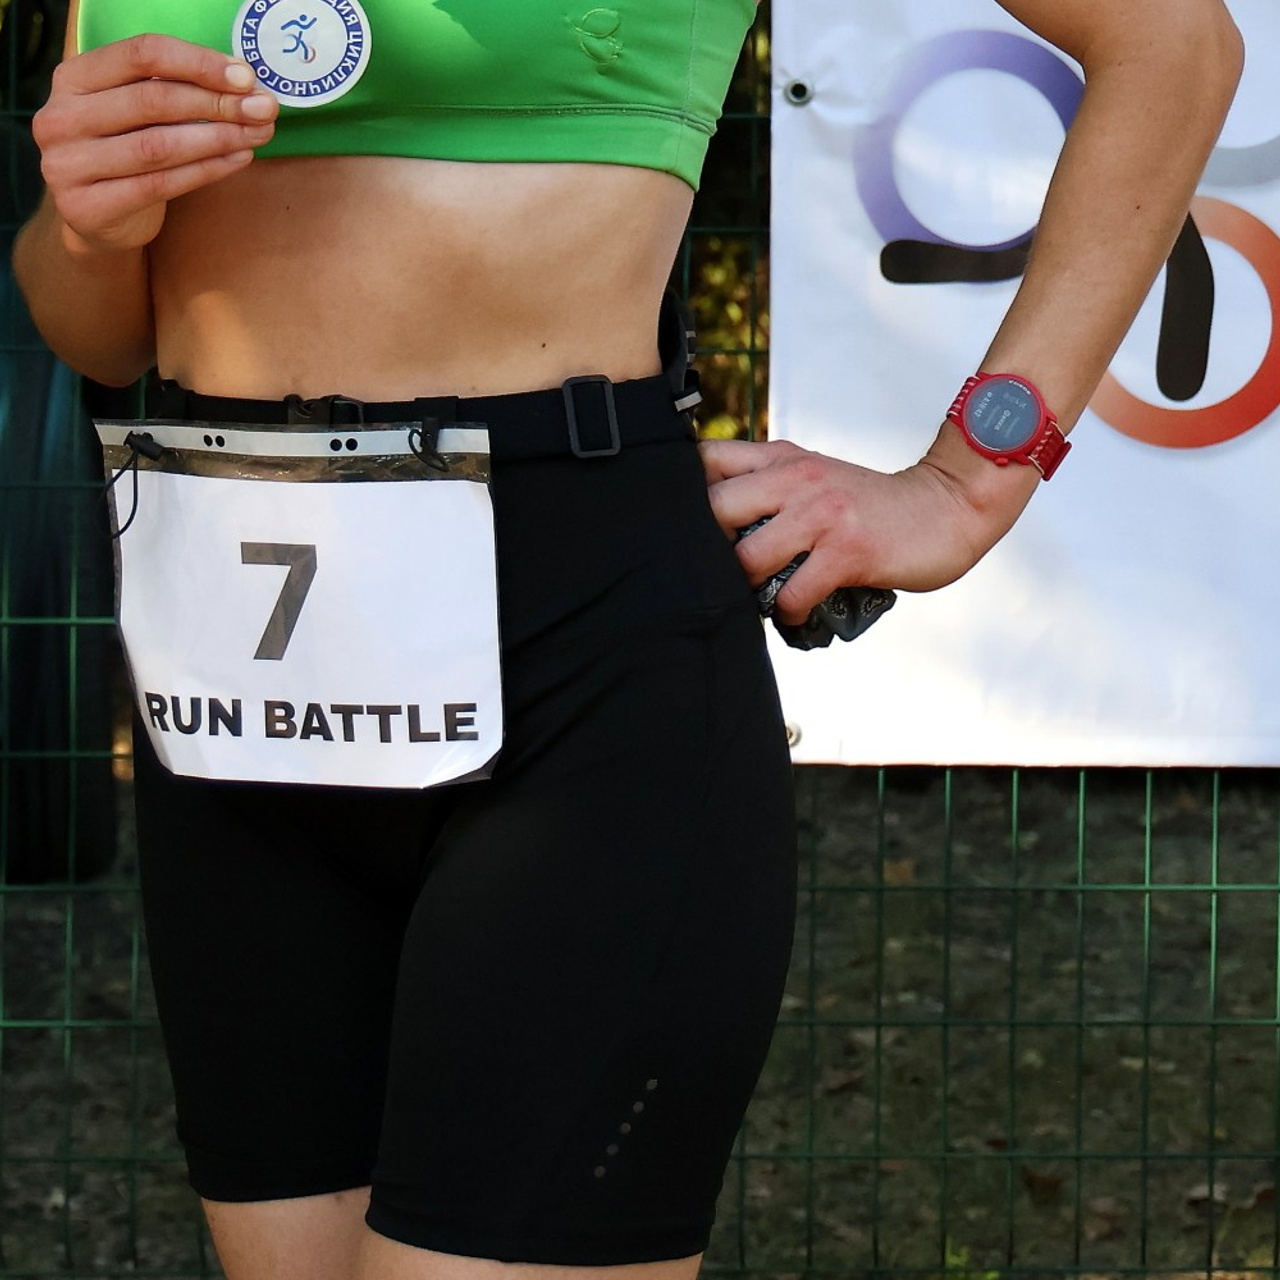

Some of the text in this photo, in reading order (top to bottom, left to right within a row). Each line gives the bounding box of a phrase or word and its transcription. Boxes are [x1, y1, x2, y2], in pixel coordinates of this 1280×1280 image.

[243, 18, 260, 63] БЕГА
[257, 31, 362, 95] ЦИКЛИЧНОГО
[241, 541, 318, 661] 7
[144, 691, 479, 744] RUN BATTLE
